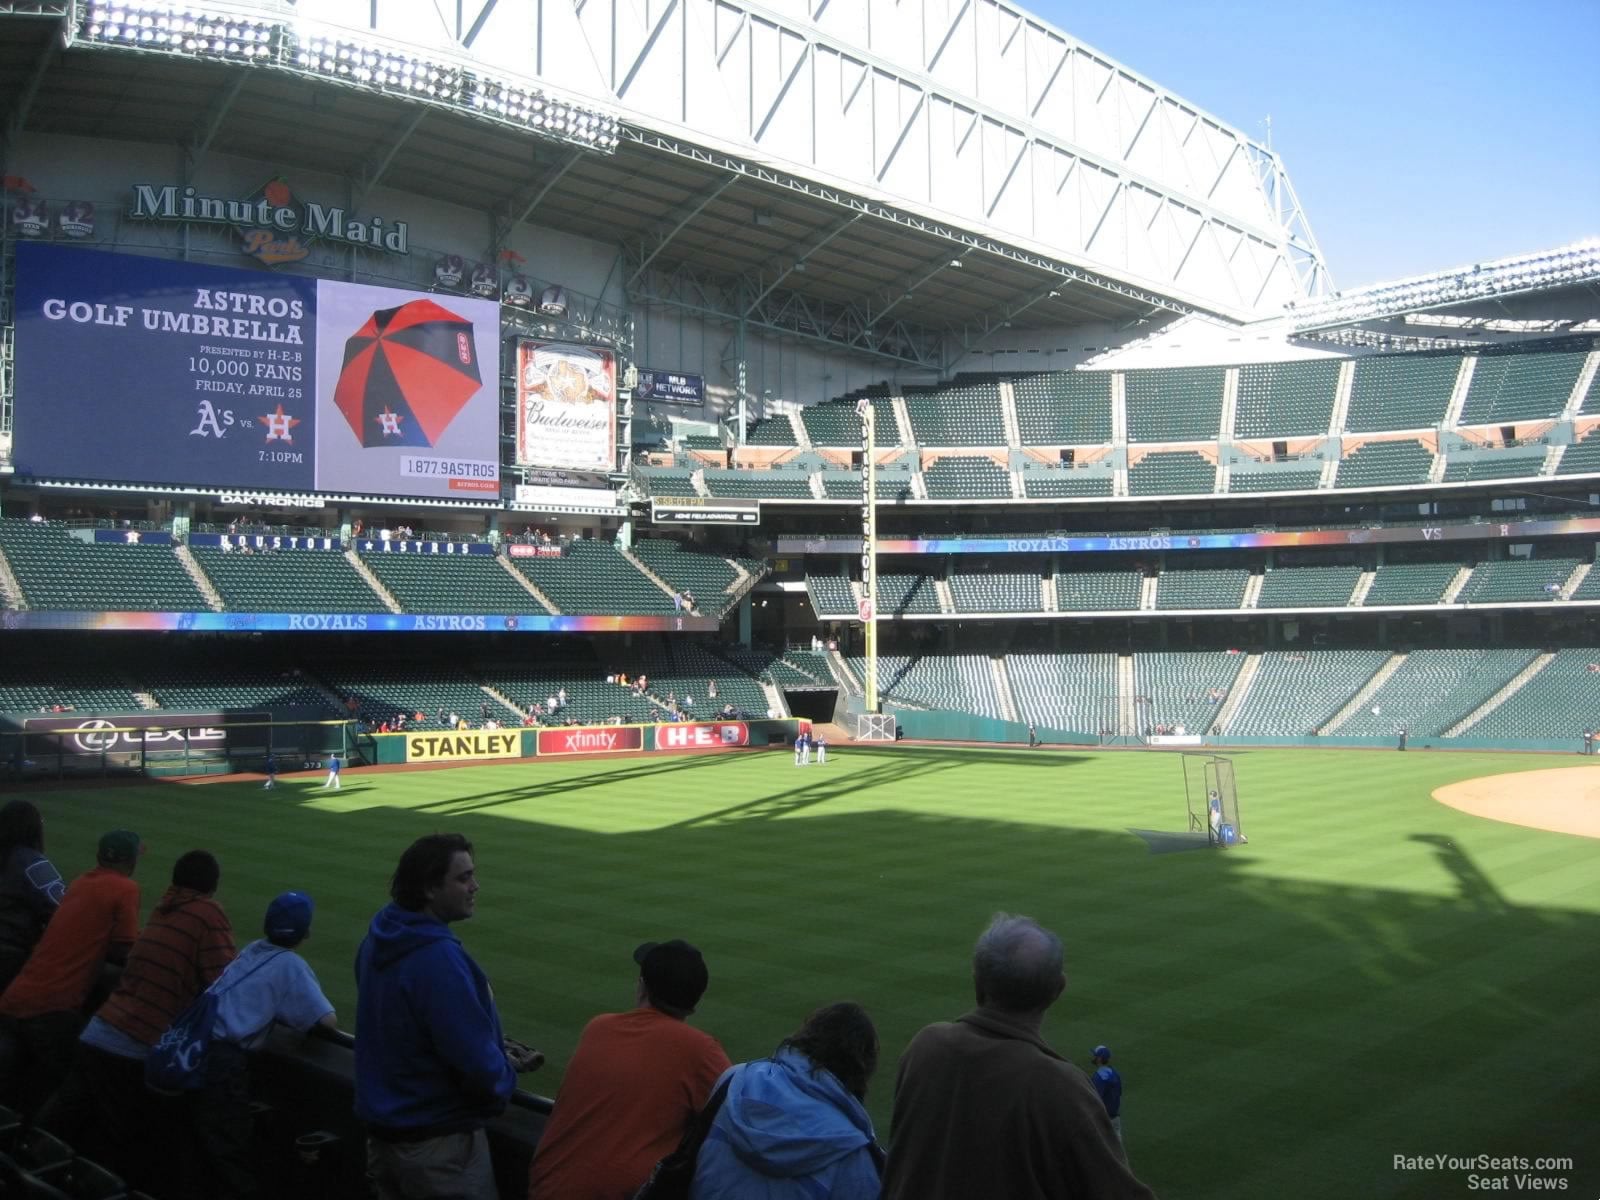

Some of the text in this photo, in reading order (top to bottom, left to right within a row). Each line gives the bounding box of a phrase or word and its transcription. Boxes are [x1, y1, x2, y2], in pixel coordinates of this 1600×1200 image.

[133, 185, 408, 254] Minute Maid
[194, 288, 303, 319] ASTROS
[43, 299, 304, 345] GOLF UMBRELLA
[200, 345, 302, 362] PRESENTED BY H-E-B
[190, 357, 302, 381] 10,000 FANS
[196, 380, 302, 398] FRIDAY, APRIL 25
[655, 382, 697, 396] NETWORK
[668, 375, 687, 386] MLB
[526, 399, 608, 430] Budweiser
[259, 450, 303, 463] 7:10PM
[408, 459, 495, 477] 1.877.9ASTROS
[221, 495, 326, 508] DAKTRONICS
[220, 534, 469, 554] HOUSTON ASTROS
[1007, 538, 1069, 552] ROYALS
[1109, 536, 1171, 550] ASTROS
[288, 614, 367, 631] ROYALS
[414, 615, 486, 631] ASTROS
[123, 728, 226, 743] LEXUS
[565, 731, 616, 750] xfinity
[668, 725, 740, 746] H-E-B
[411, 735, 517, 758] STANLEY
